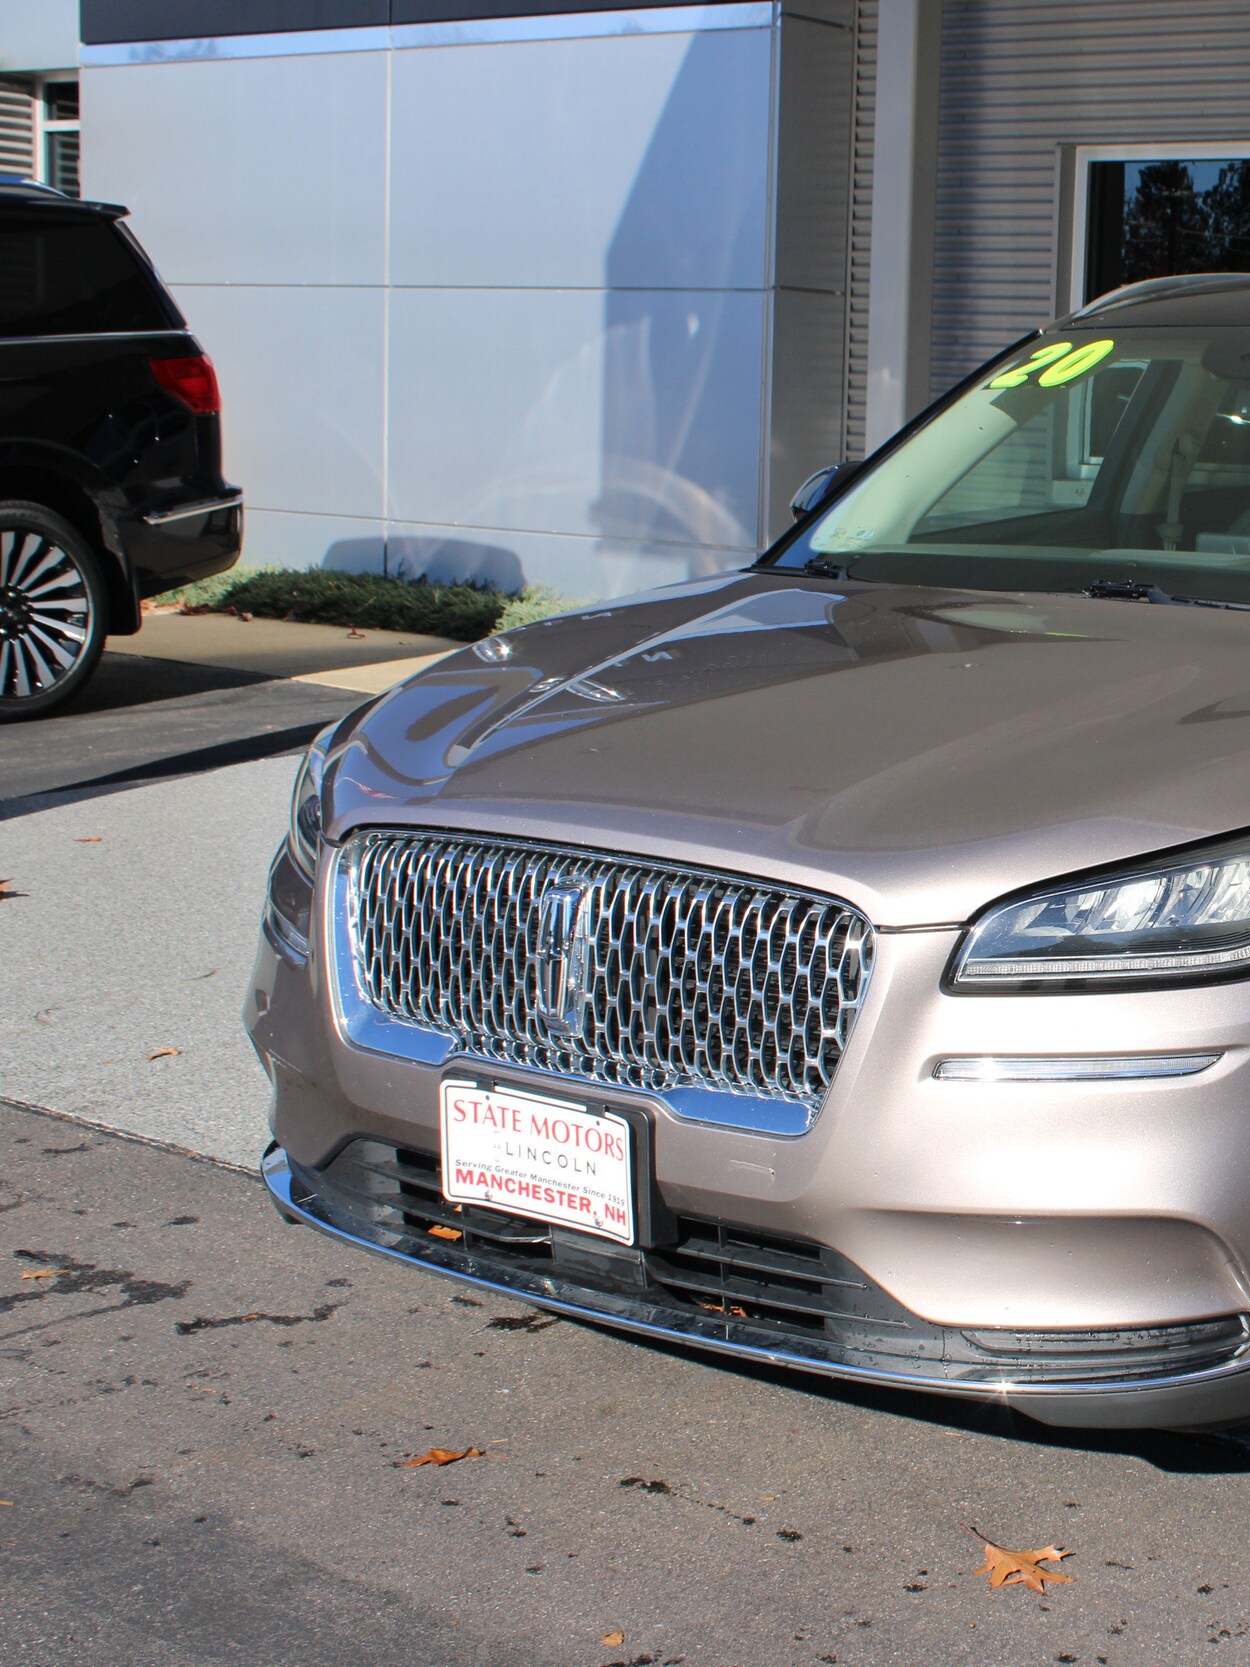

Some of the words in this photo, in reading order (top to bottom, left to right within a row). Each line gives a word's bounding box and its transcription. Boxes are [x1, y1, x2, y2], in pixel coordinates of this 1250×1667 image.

[989, 340, 1115, 389] 20
[453, 1099, 522, 1133] STATE
[530, 1114, 625, 1162] MOTORS
[455, 1158, 493, 1173] Serving
[494, 1165, 528, 1179] Greater
[530, 1173, 581, 1192] Manchester
[582, 1186, 606, 1199] Since
[607, 1193, 626, 1207] 1919
[506, 1141, 597, 1176] LINCOLN
[455, 1168, 598, 1219] MANCHESTER,
[604, 1203, 627, 1227] NH
